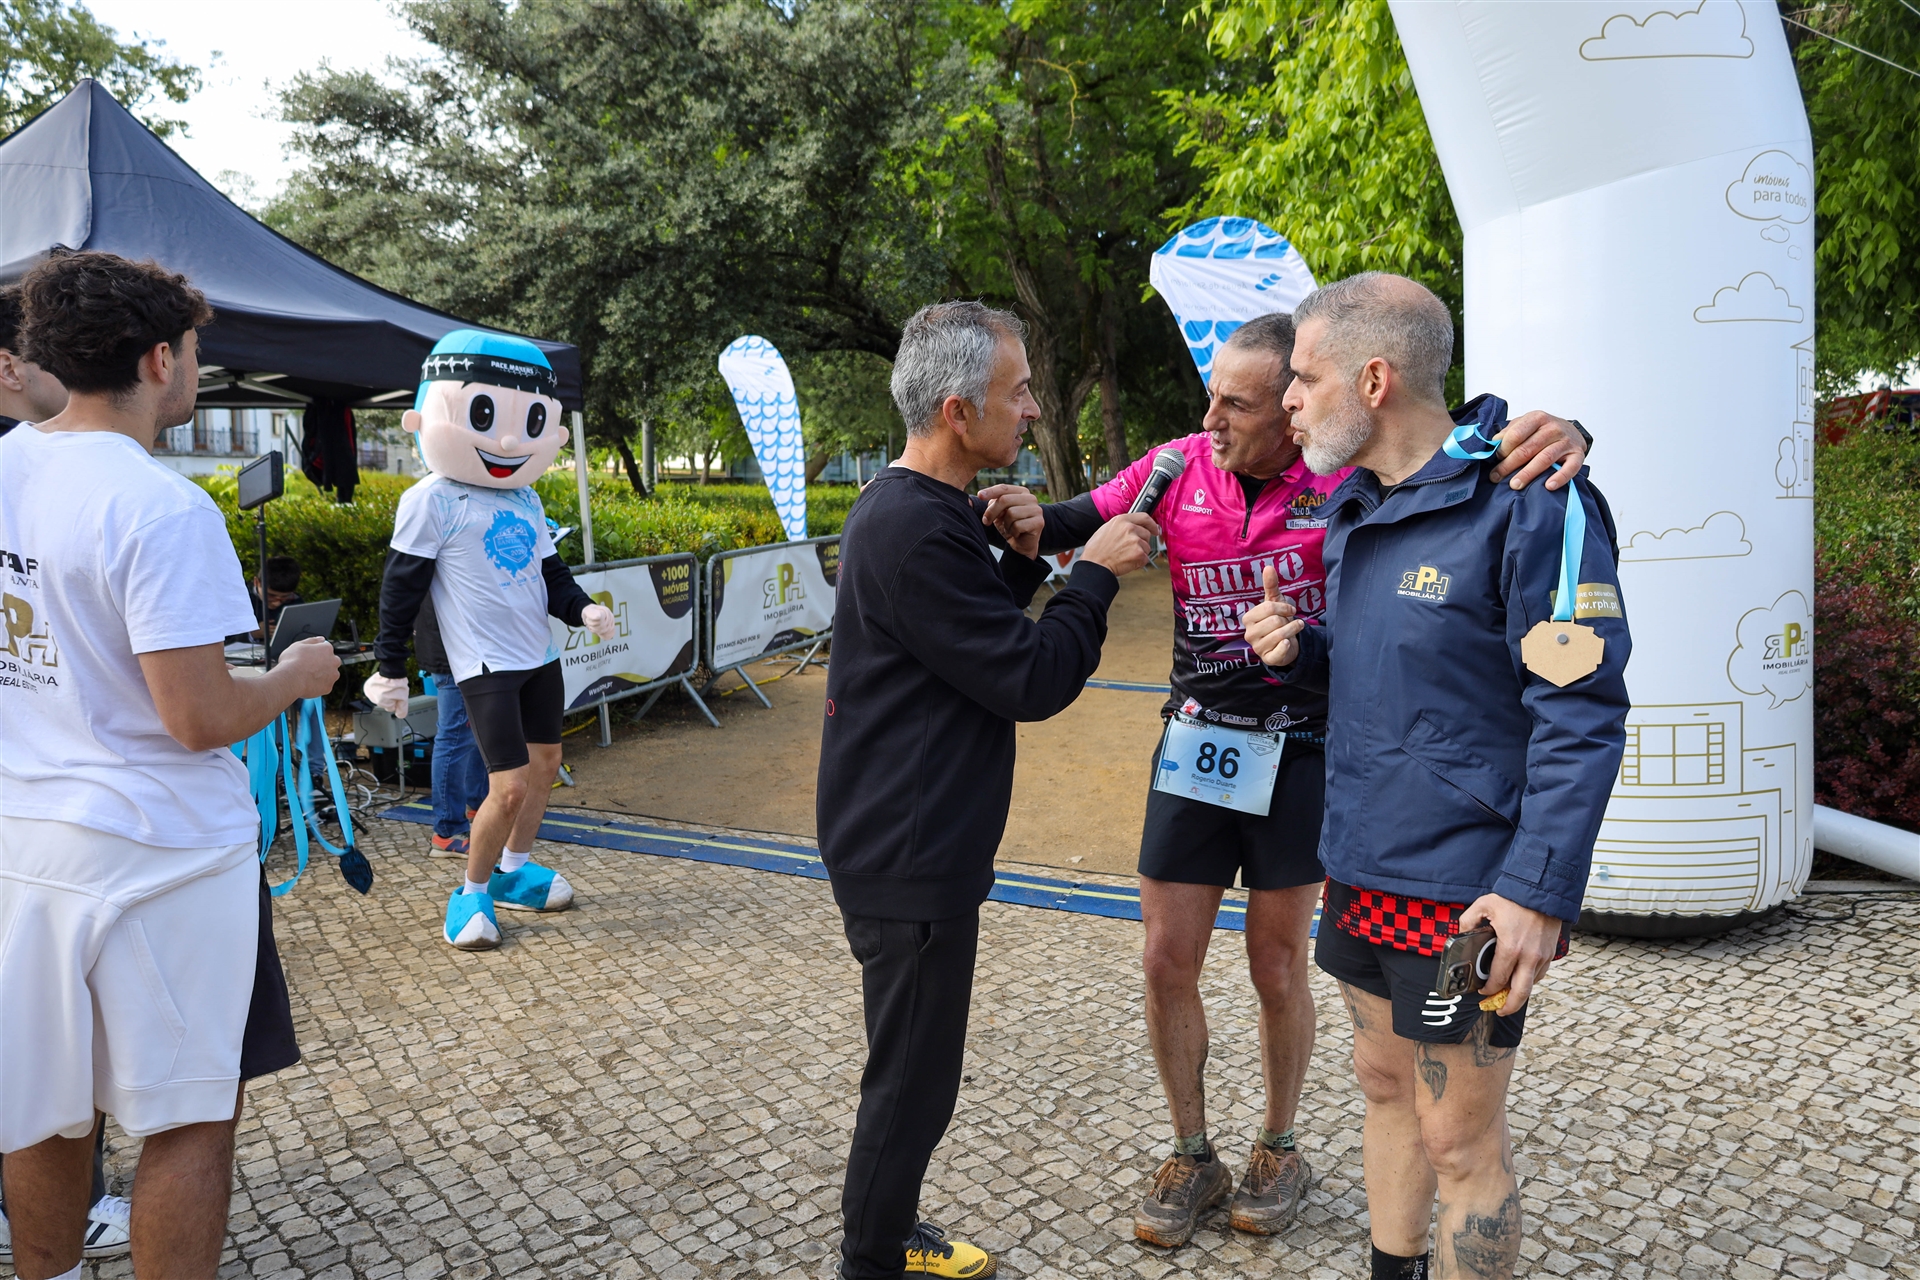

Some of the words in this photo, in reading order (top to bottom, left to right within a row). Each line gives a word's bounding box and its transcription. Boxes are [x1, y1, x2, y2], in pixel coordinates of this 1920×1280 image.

[1753, 190, 1781, 203] para
[1785, 190, 1807, 208] todos
[661, 564, 689, 581] +1000
[662, 581, 689, 596] IMÓVEIS
[565, 642, 630, 667] IMOBILIÁRIA
[1762, 658, 1809, 671] IMOBILIÁRIA
[1196, 742, 1240, 779] 86
[1191, 773, 1215, 785] Rogerio
[1216, 778, 1237, 790] Duarte
